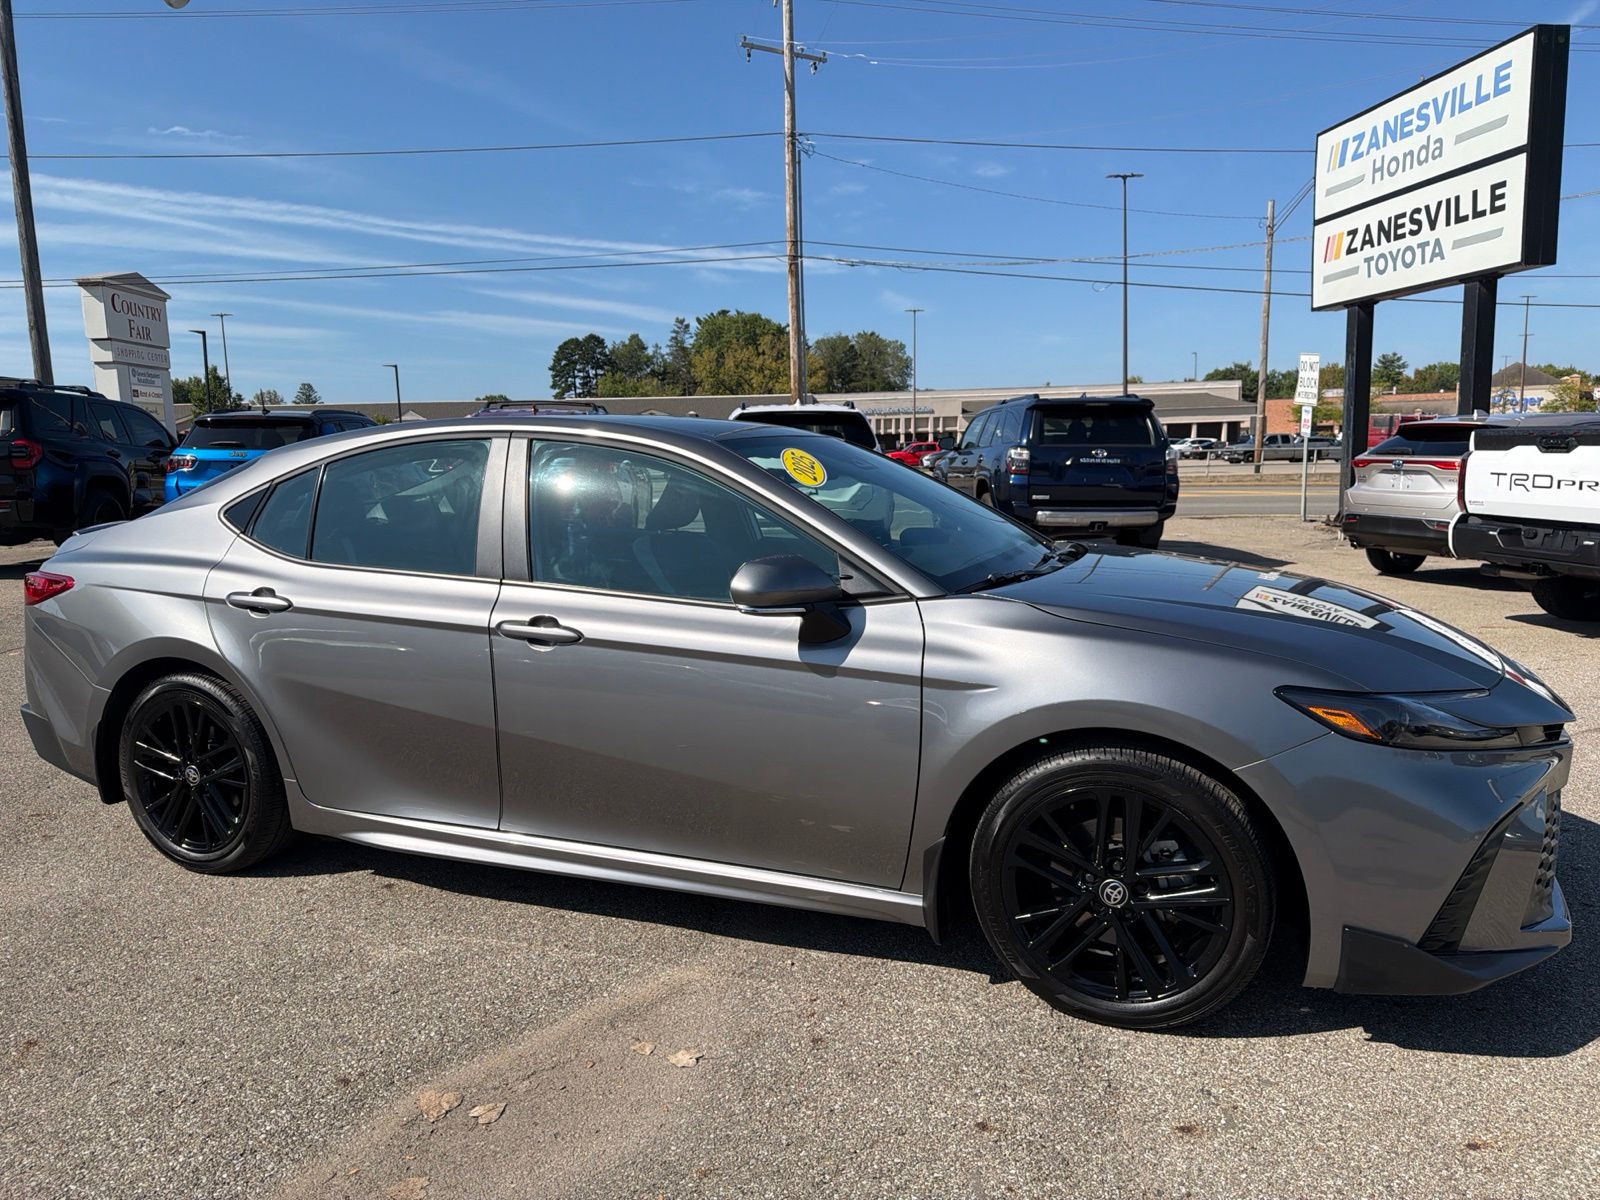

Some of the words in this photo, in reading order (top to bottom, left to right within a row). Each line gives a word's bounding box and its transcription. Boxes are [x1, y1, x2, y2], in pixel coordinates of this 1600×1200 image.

[1351, 59, 1513, 163] ZANESVILLE
[1371, 135, 1444, 185] Honda
[1345, 180, 1508, 256] ZANESVILLE
[1363, 237, 1446, 279] TOYOTA
[117, 347, 145, 360] SHOPPING
[147, 351, 168, 363] CENTER
[1300, 360, 1308, 372] DO
[1309, 361, 1319, 373] NOT
[1299, 377, 1317, 389] BLOCK
[1490, 472, 1553, 492] TRD
[1557, 479, 1600, 492] PR
